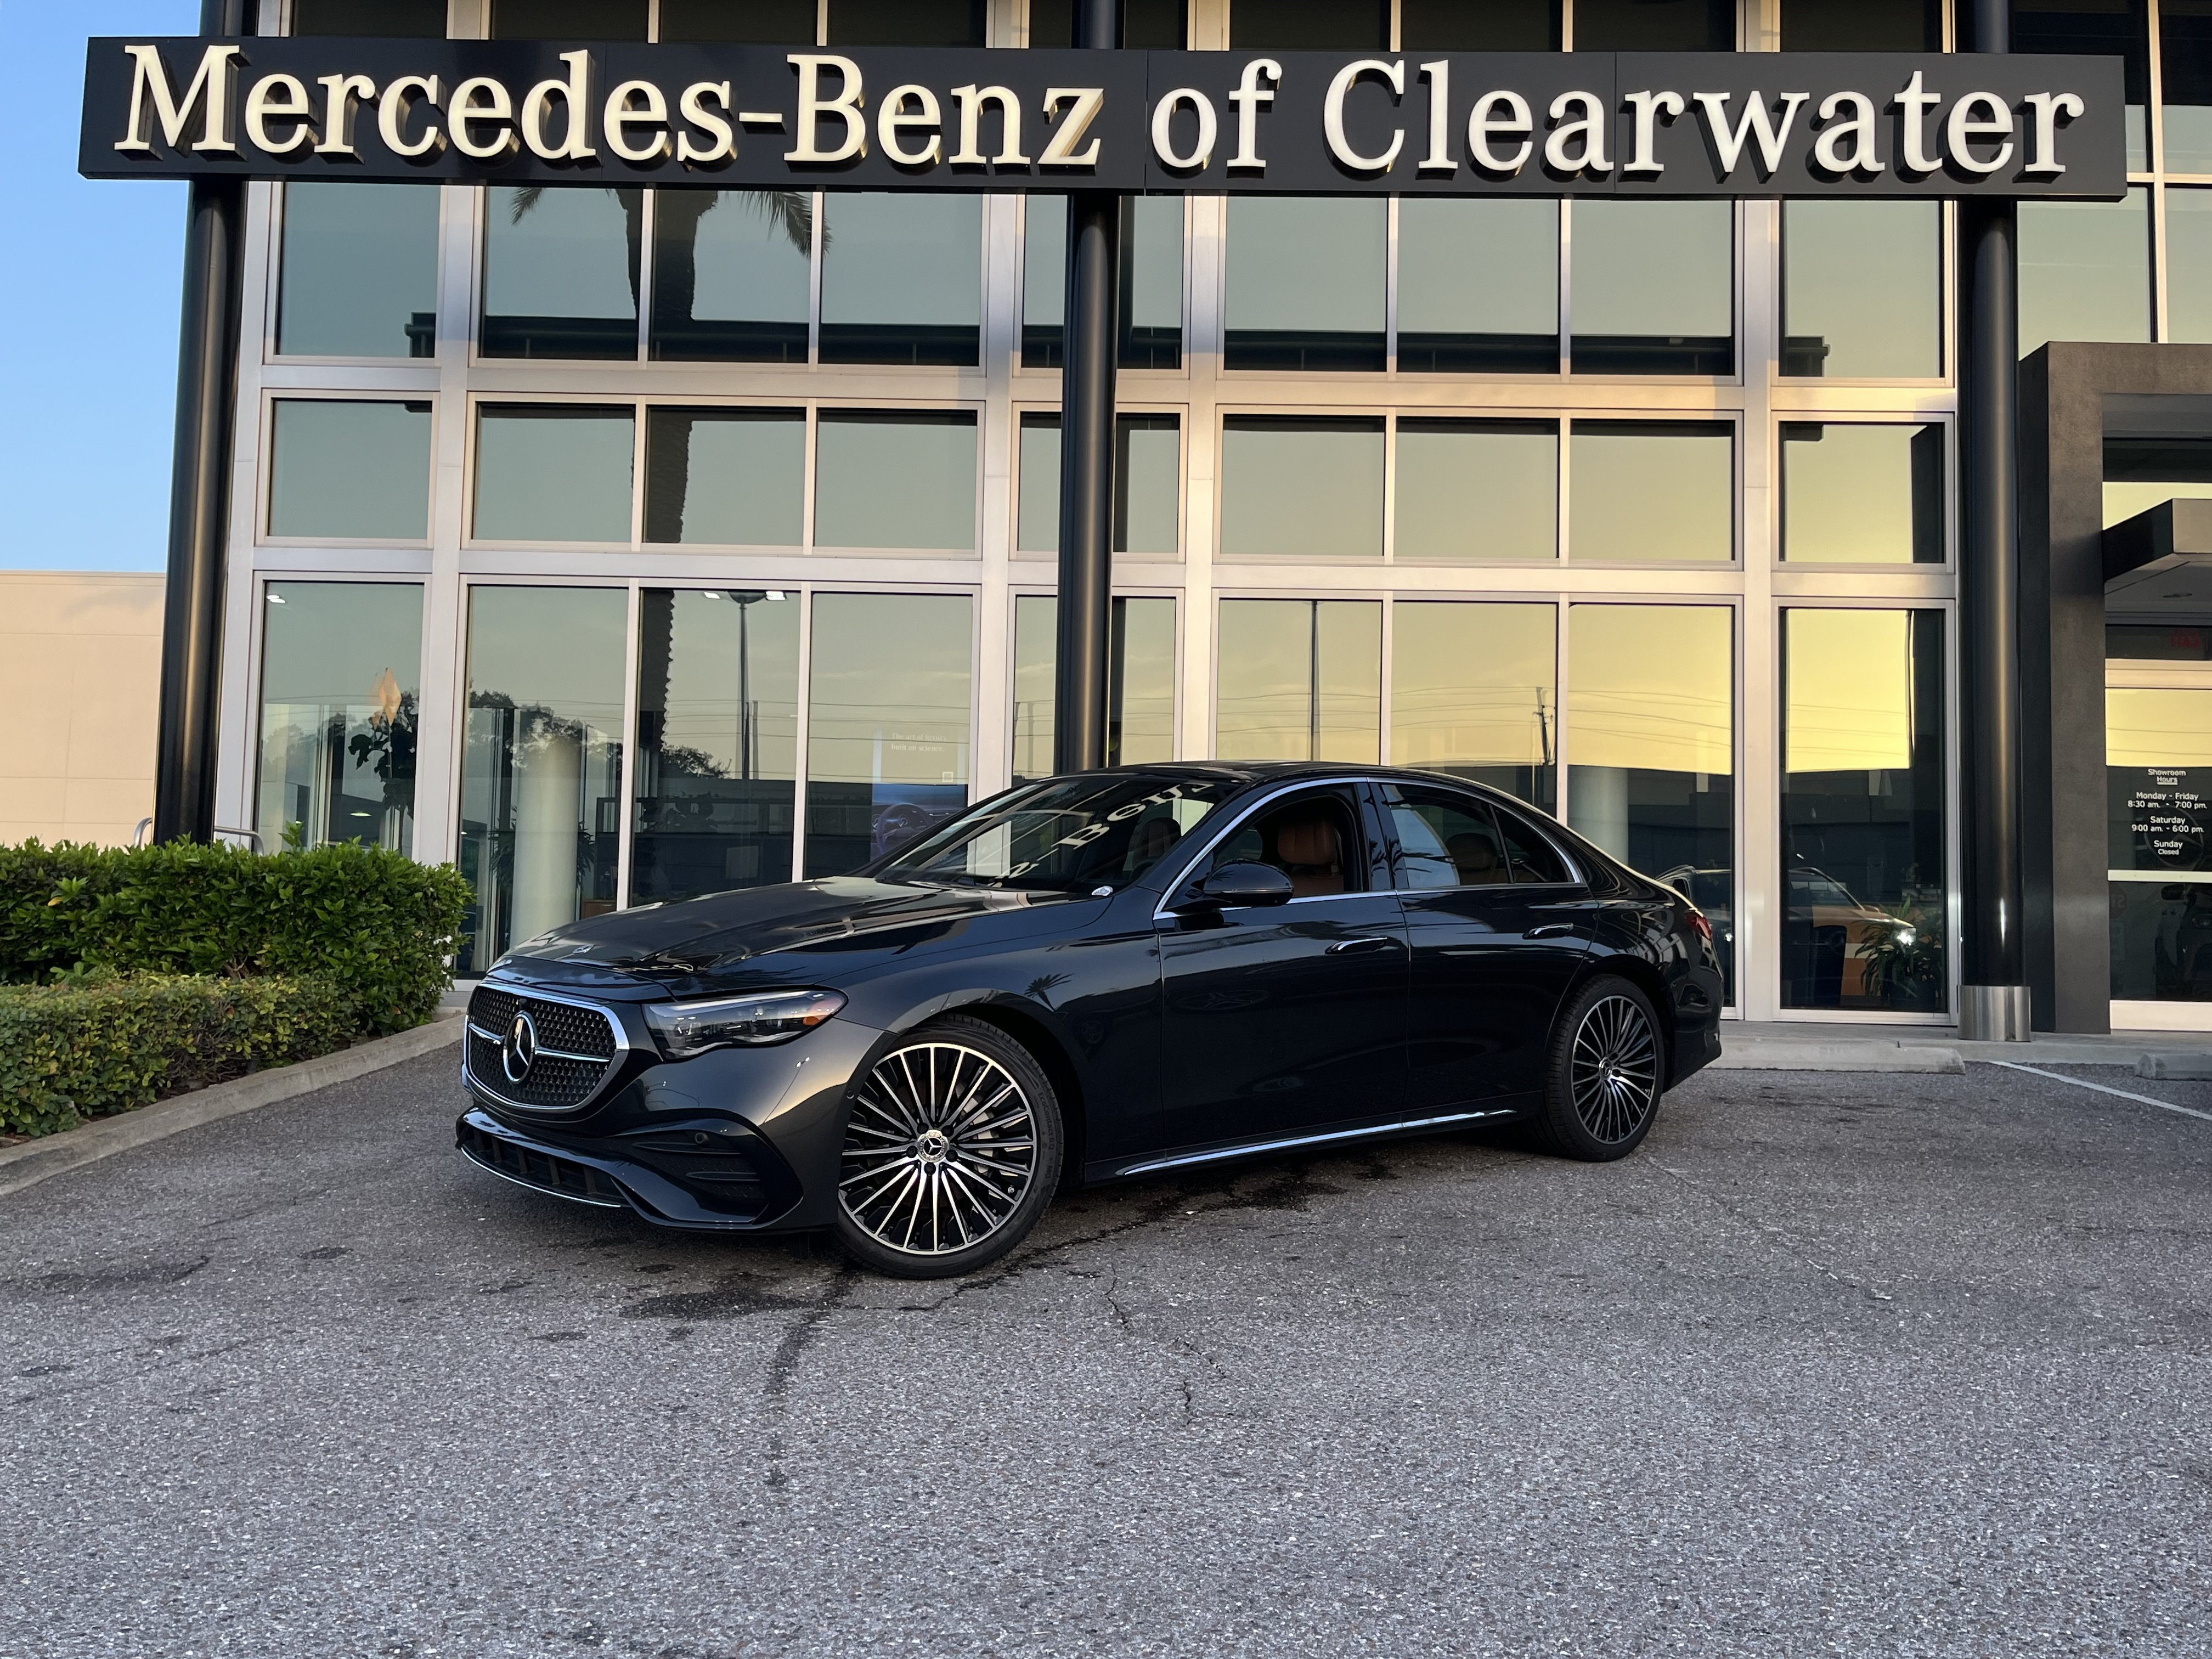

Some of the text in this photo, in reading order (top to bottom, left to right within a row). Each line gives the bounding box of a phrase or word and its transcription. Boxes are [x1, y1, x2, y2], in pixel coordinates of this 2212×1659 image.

[114, 44, 2085, 173] Mercedes-Benz of Clearwater
[891, 743, 906, 751] built
[2136, 792, 2166, 800] Monday
[2175, 792, 2199, 801] Friday
[2150, 816, 2186, 825] Saturday
[2154, 840, 2183, 849] Sunday
